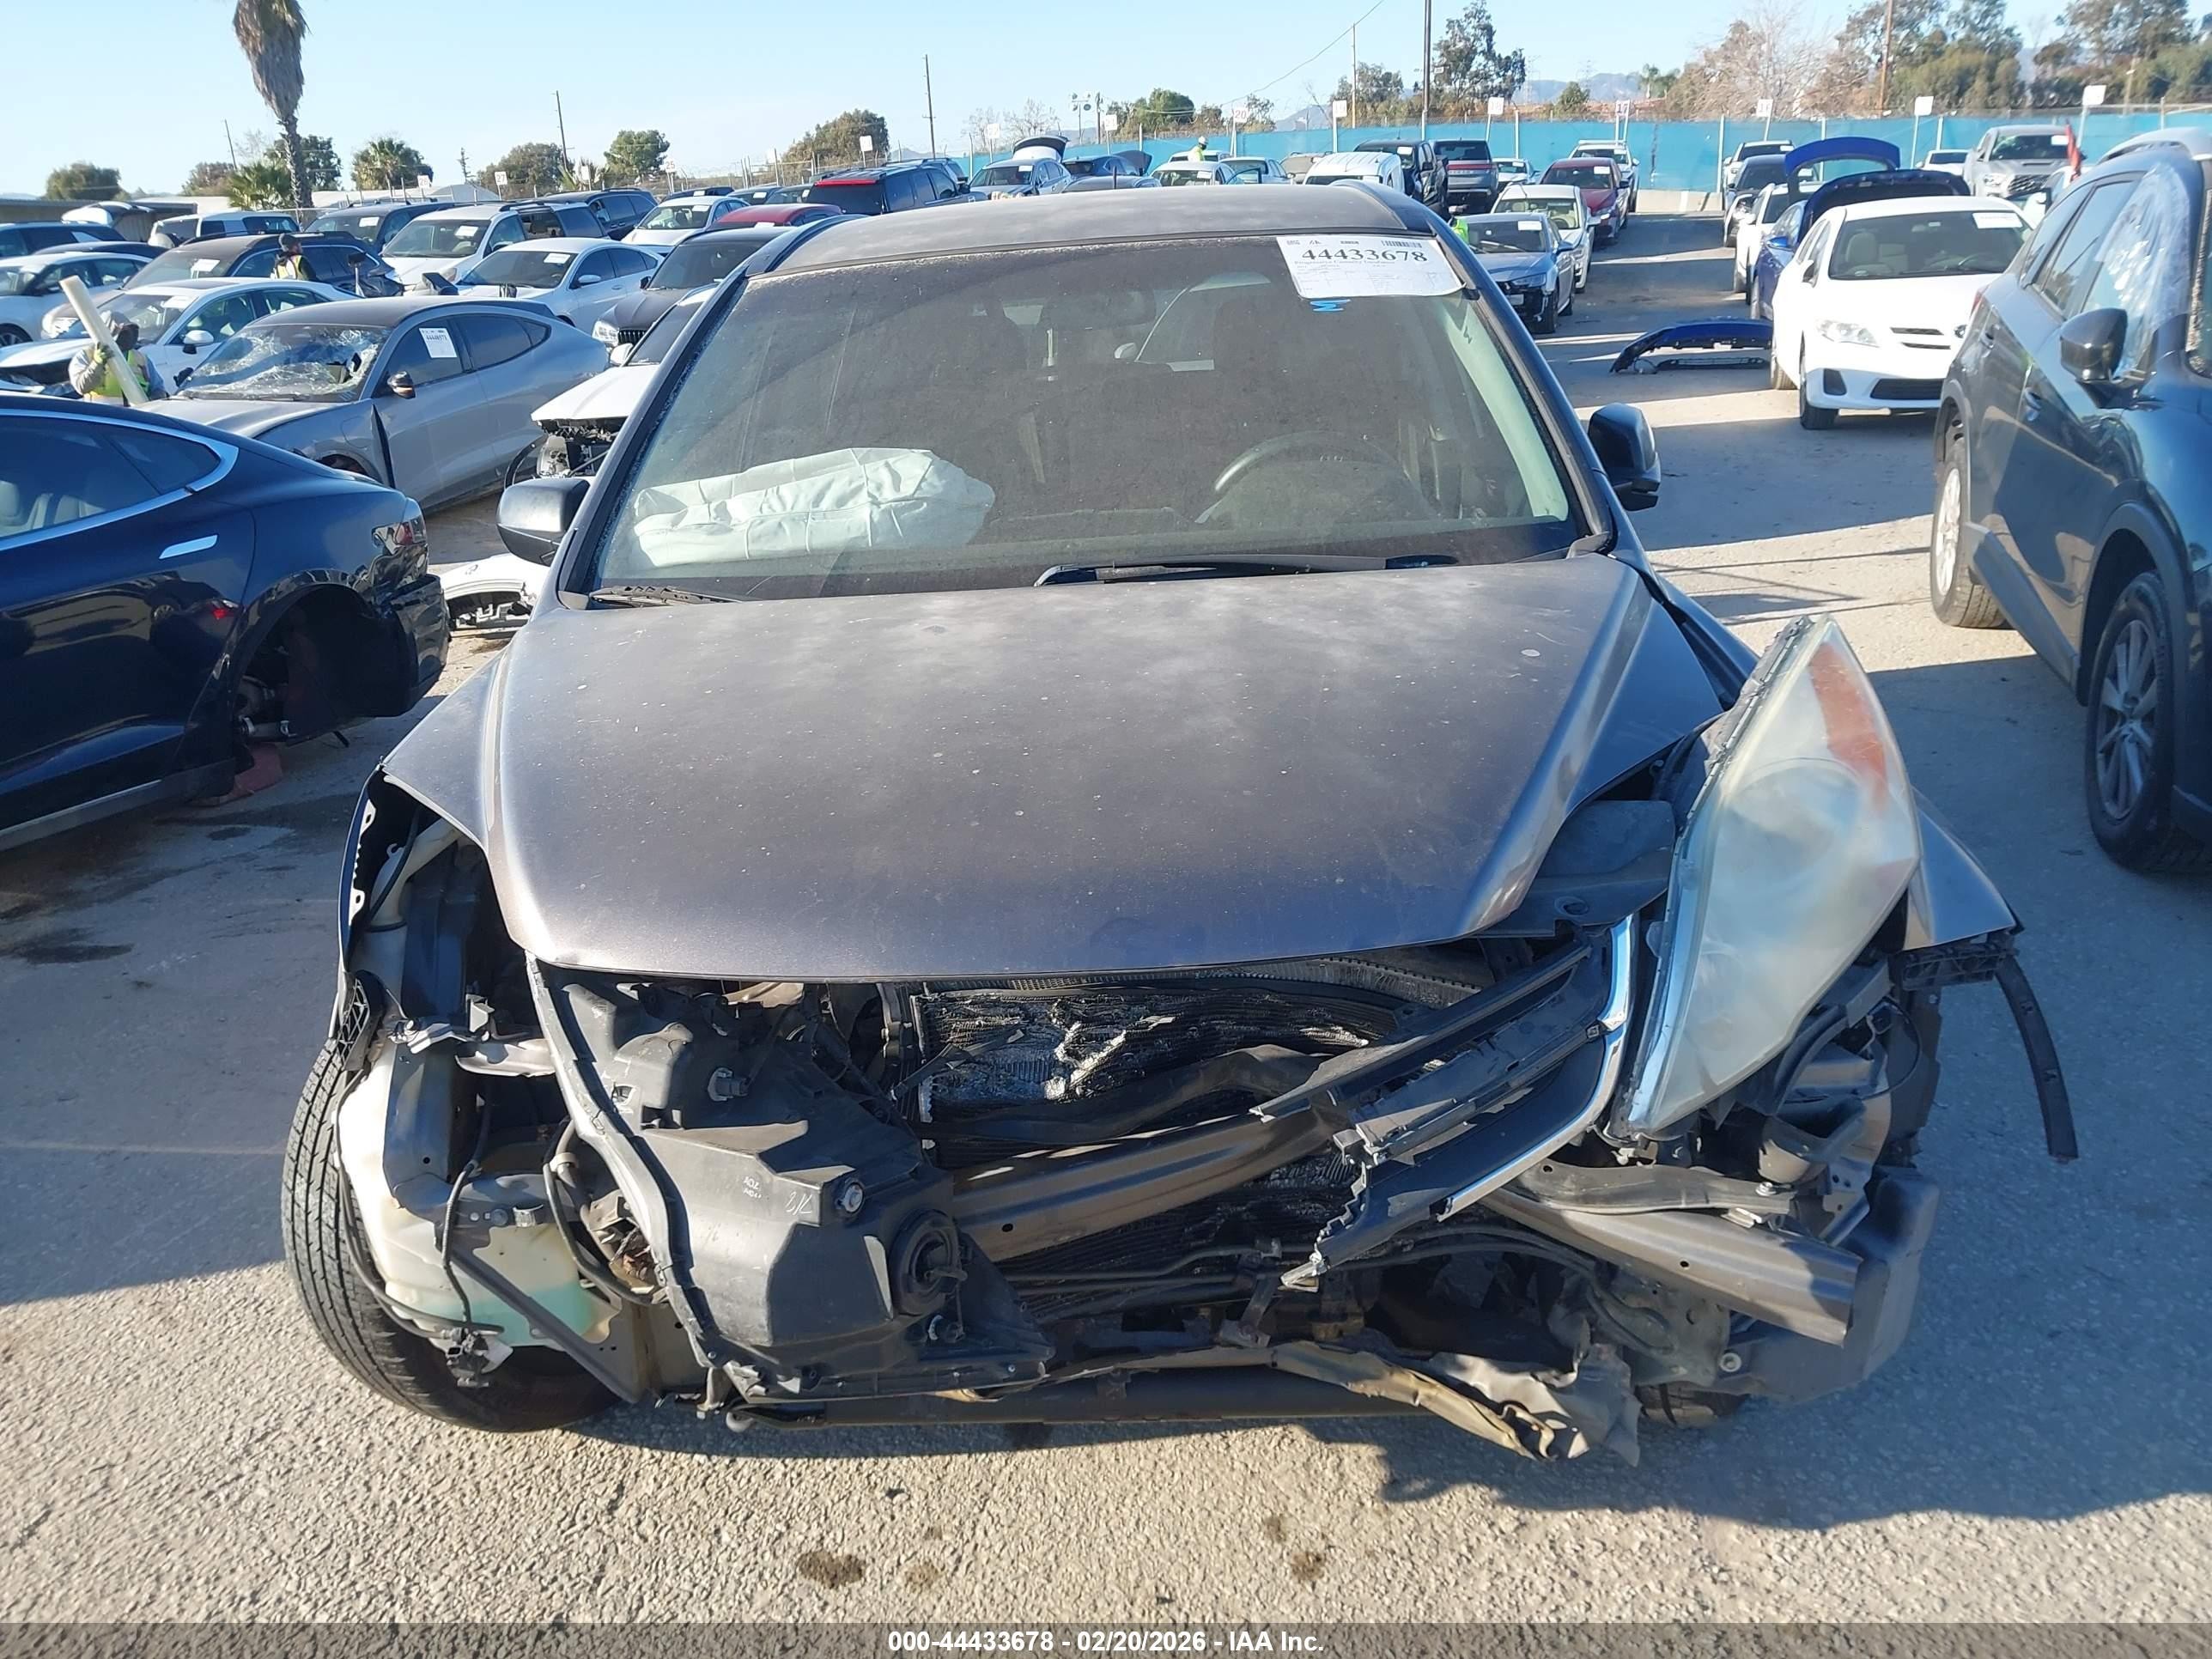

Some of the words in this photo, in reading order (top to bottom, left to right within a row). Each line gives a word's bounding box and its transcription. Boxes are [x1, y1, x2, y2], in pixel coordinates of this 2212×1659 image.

[1235, 109, 1248, 119] 20
[665, 161, 676, 170] 25
[496, 173, 506, 183] 27
[1302, 249, 1428, 262] 44433678
